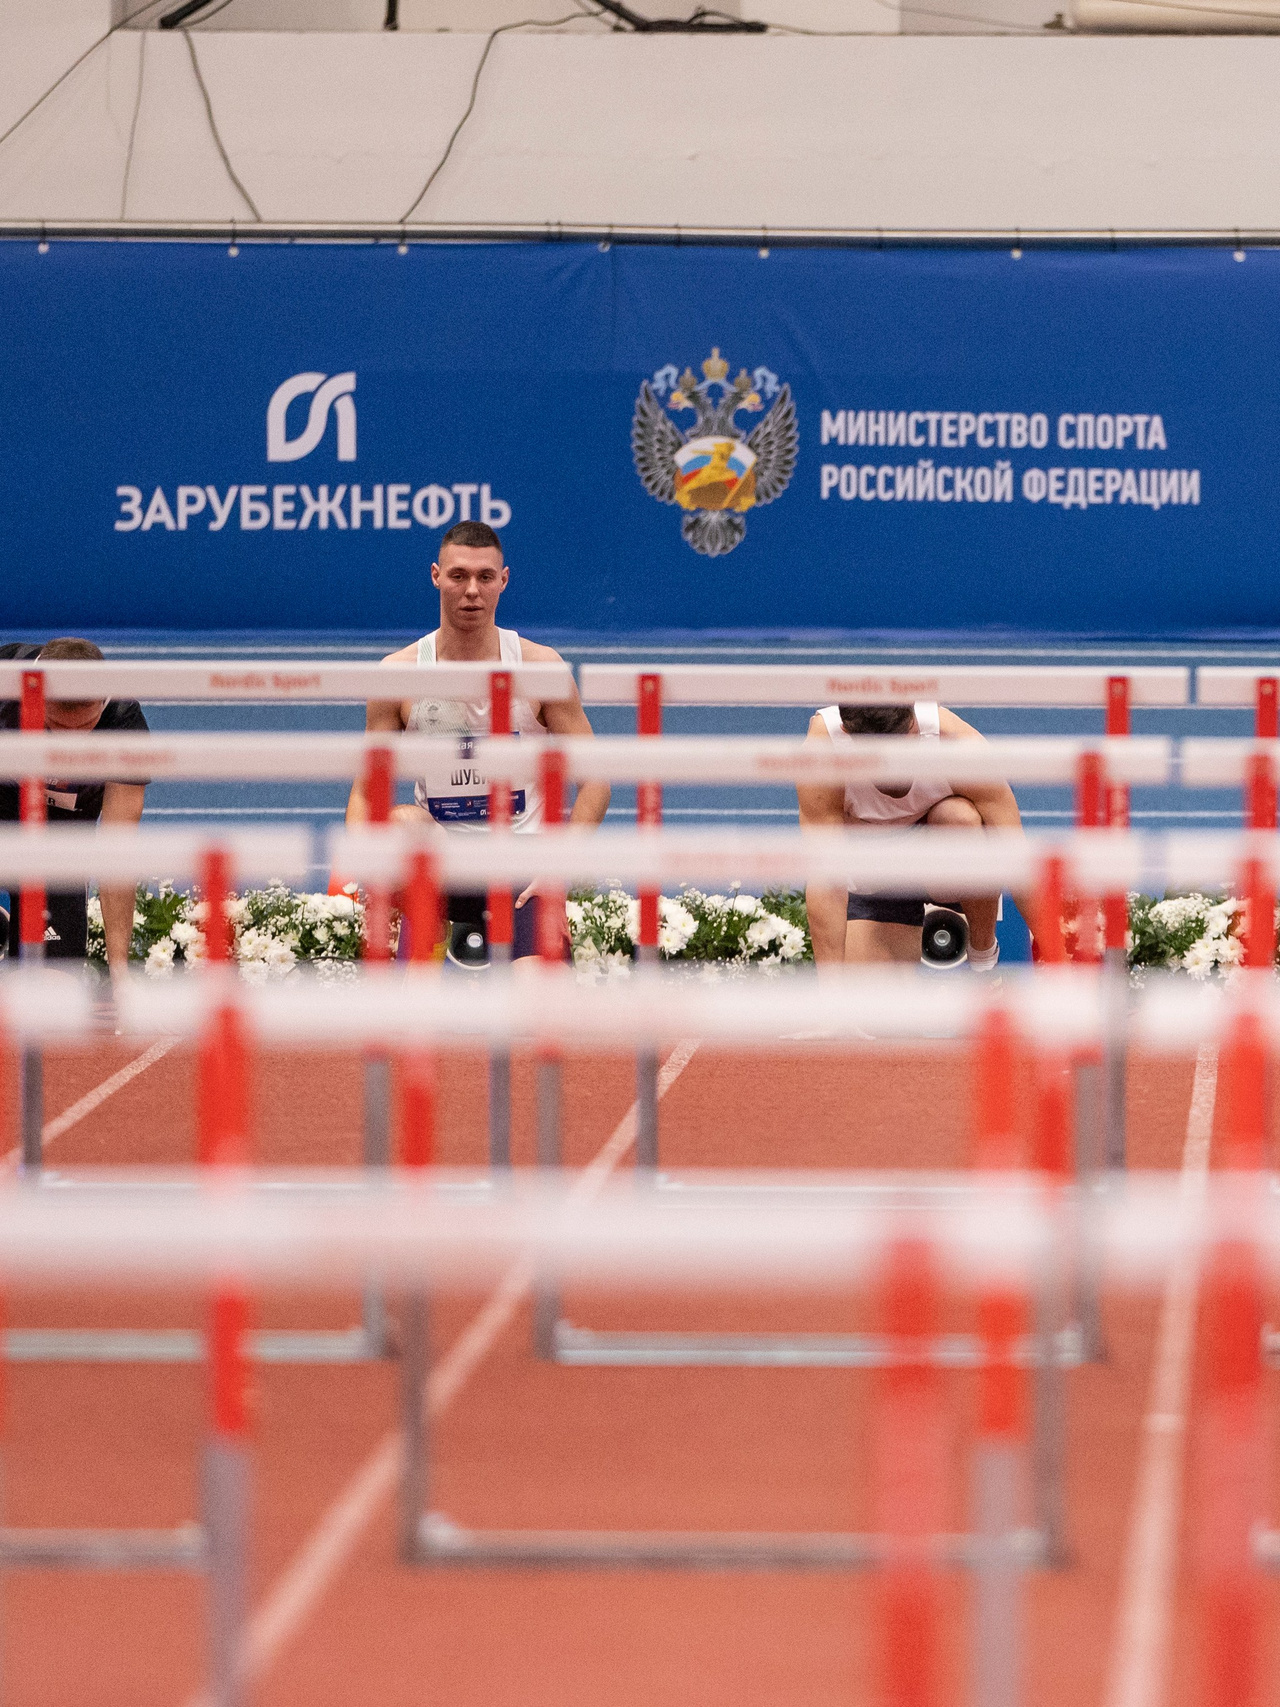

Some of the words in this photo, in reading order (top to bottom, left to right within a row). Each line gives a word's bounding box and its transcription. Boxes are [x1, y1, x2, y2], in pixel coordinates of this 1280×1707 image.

[820, 410, 1049, 448] МИНИСТЕРСТВО
[1057, 414, 1167, 450] СПОРТА
[115, 484, 512, 532] ЗАРУБЕЖНЕФТЬ
[820, 461, 1013, 502] РОССИЙСКОЙ
[1022, 468, 1200, 510] ФЕДЕРАЦИИ
